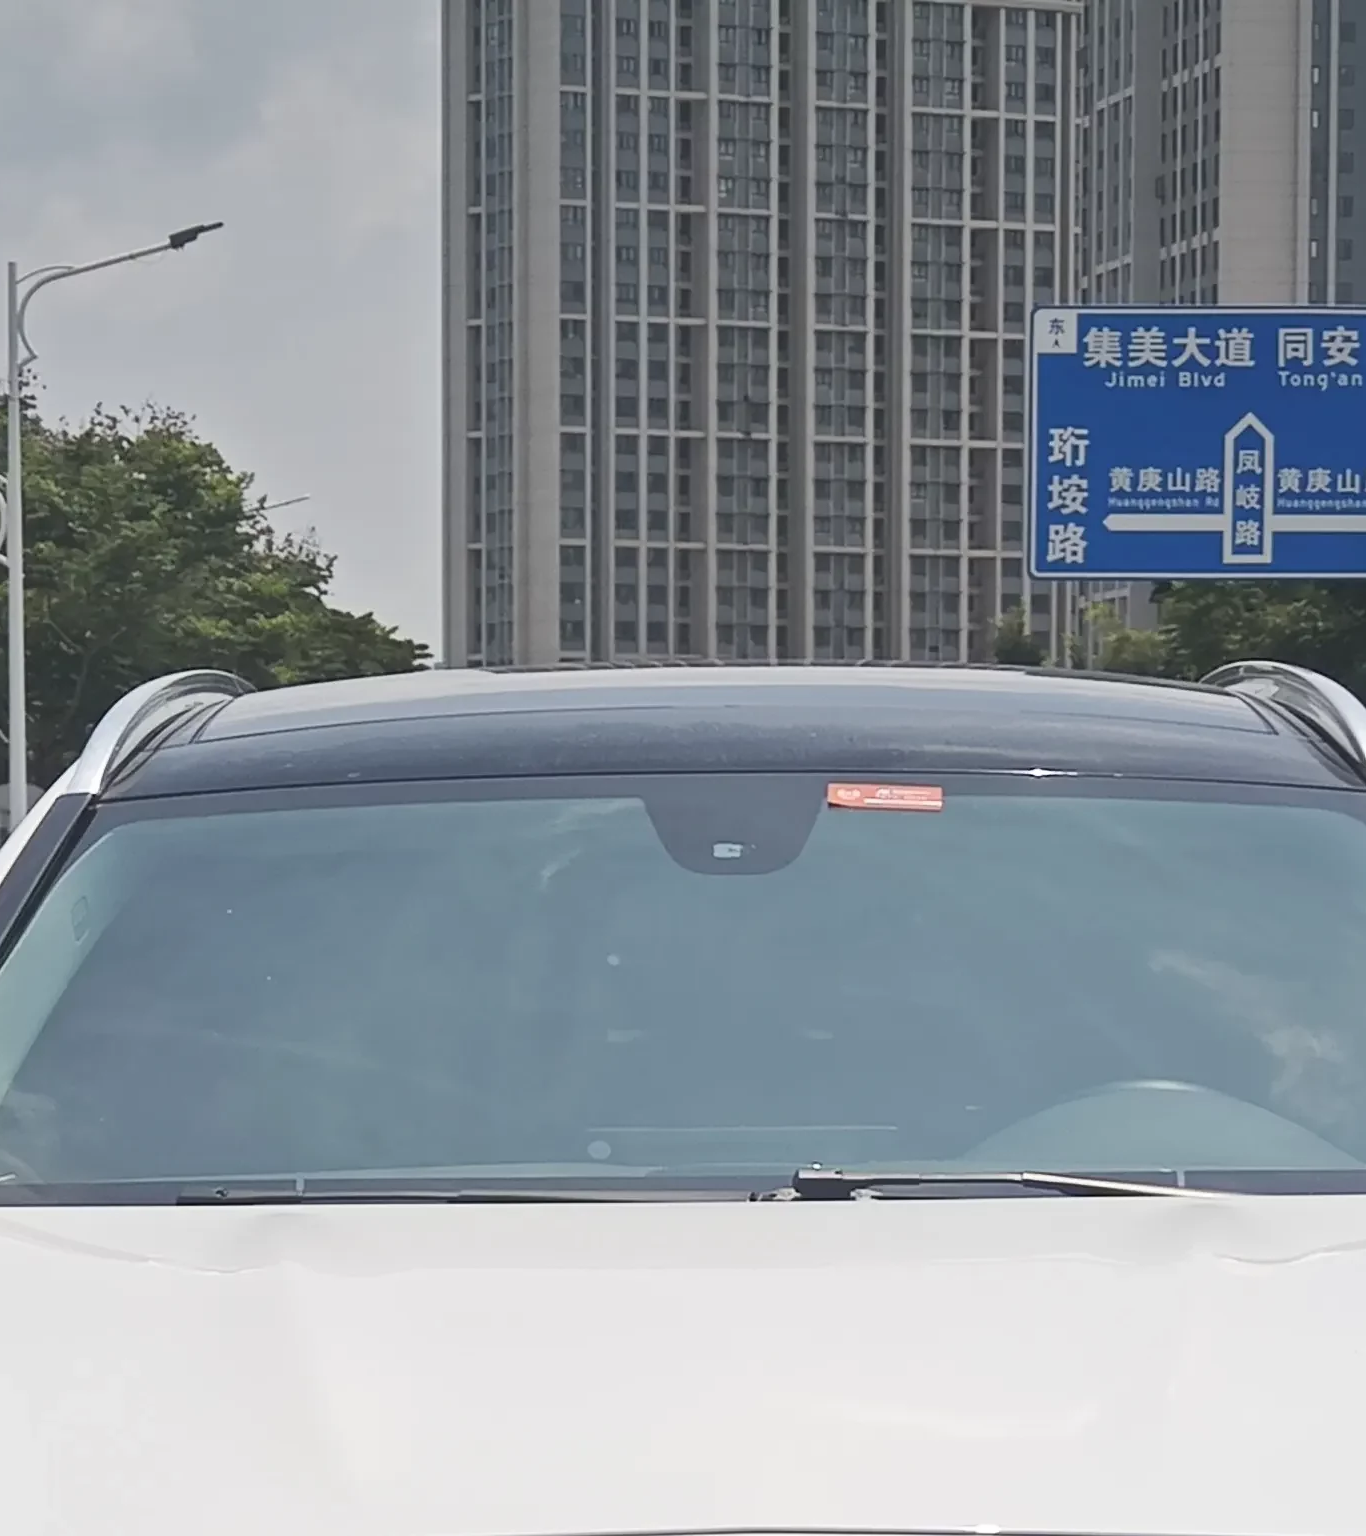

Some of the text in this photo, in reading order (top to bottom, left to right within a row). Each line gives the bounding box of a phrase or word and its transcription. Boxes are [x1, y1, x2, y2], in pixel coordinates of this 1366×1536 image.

[1048, 317, 1066, 336] 东
[1082, 325, 1361, 368] 集美大道 同安
[1104, 371, 1364, 391] Jimei Blvd Tong'an
[1108, 466, 1221, 493] 黄庚山路
[1046, 425, 1091, 564] 珩垵路
[1205, 496, 1220, 508] Rd
